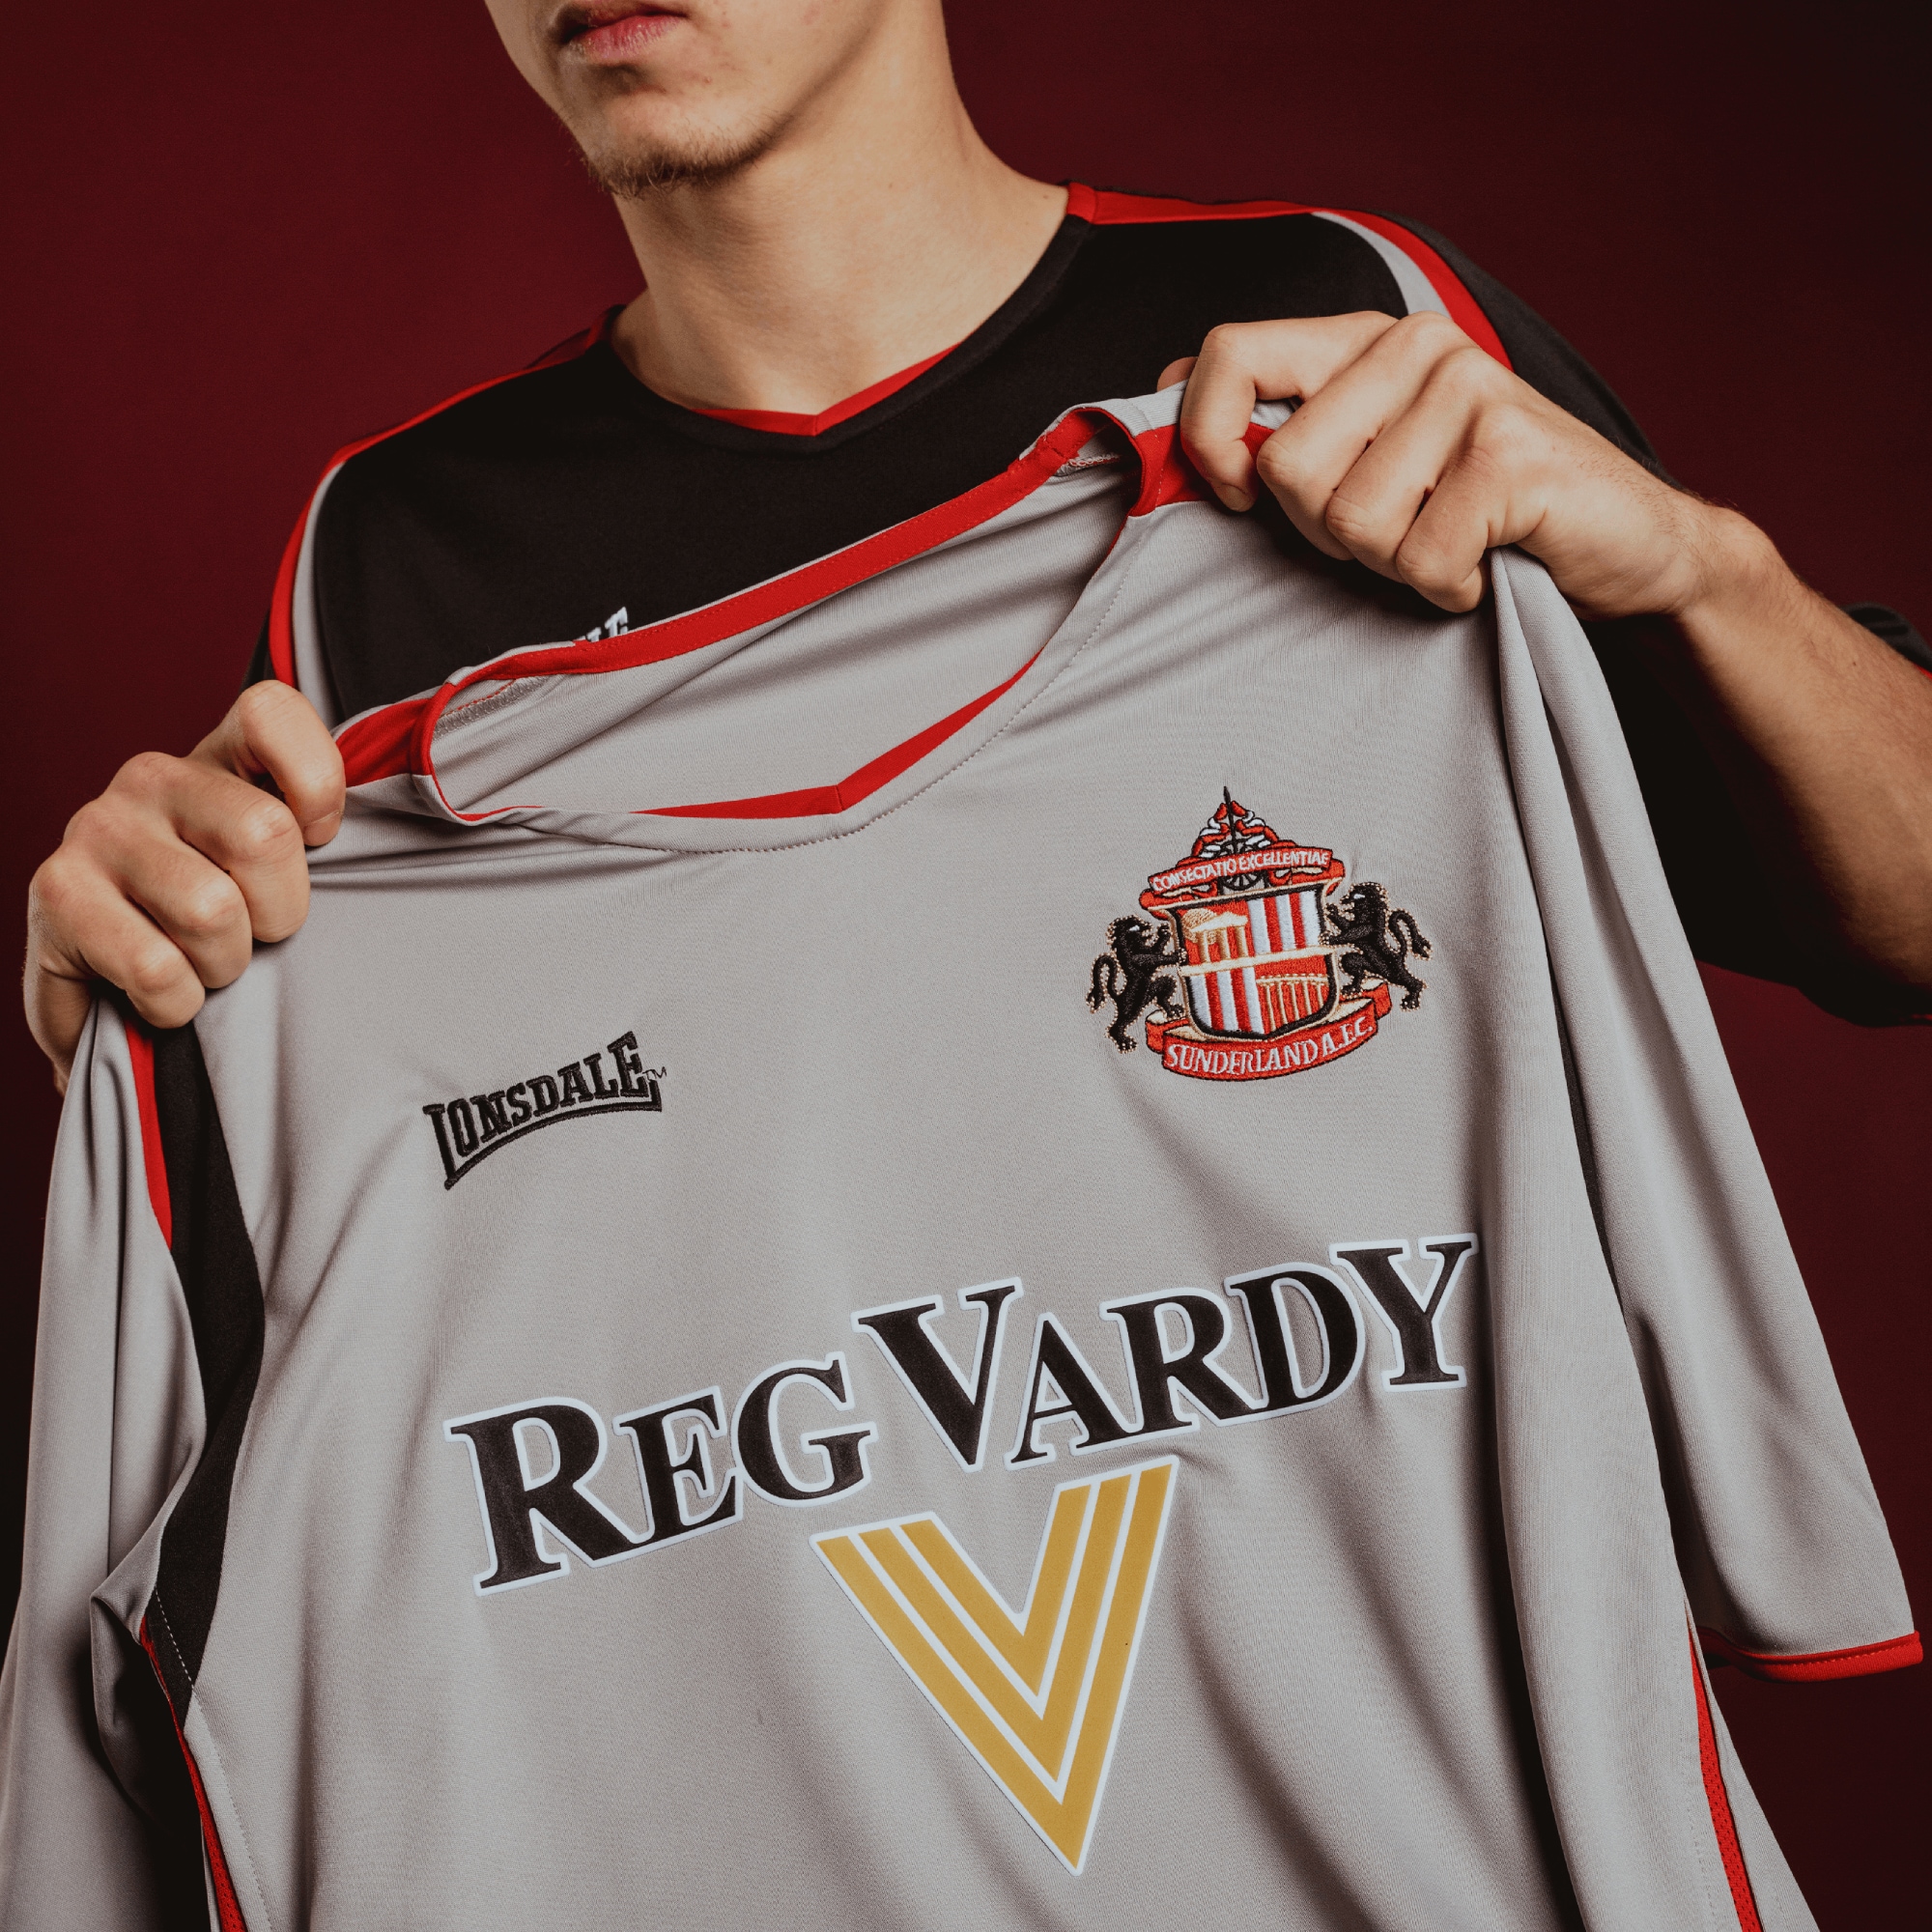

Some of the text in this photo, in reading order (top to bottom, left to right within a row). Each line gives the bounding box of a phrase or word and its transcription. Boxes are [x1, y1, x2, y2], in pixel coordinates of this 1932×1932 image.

[1152, 849, 1330, 892] CONSECTATIO EXCELLENTIAE
[1163, 1038, 1320, 1075] SUNDERLAND
[422, 1031, 663, 1190] LONSDALE
